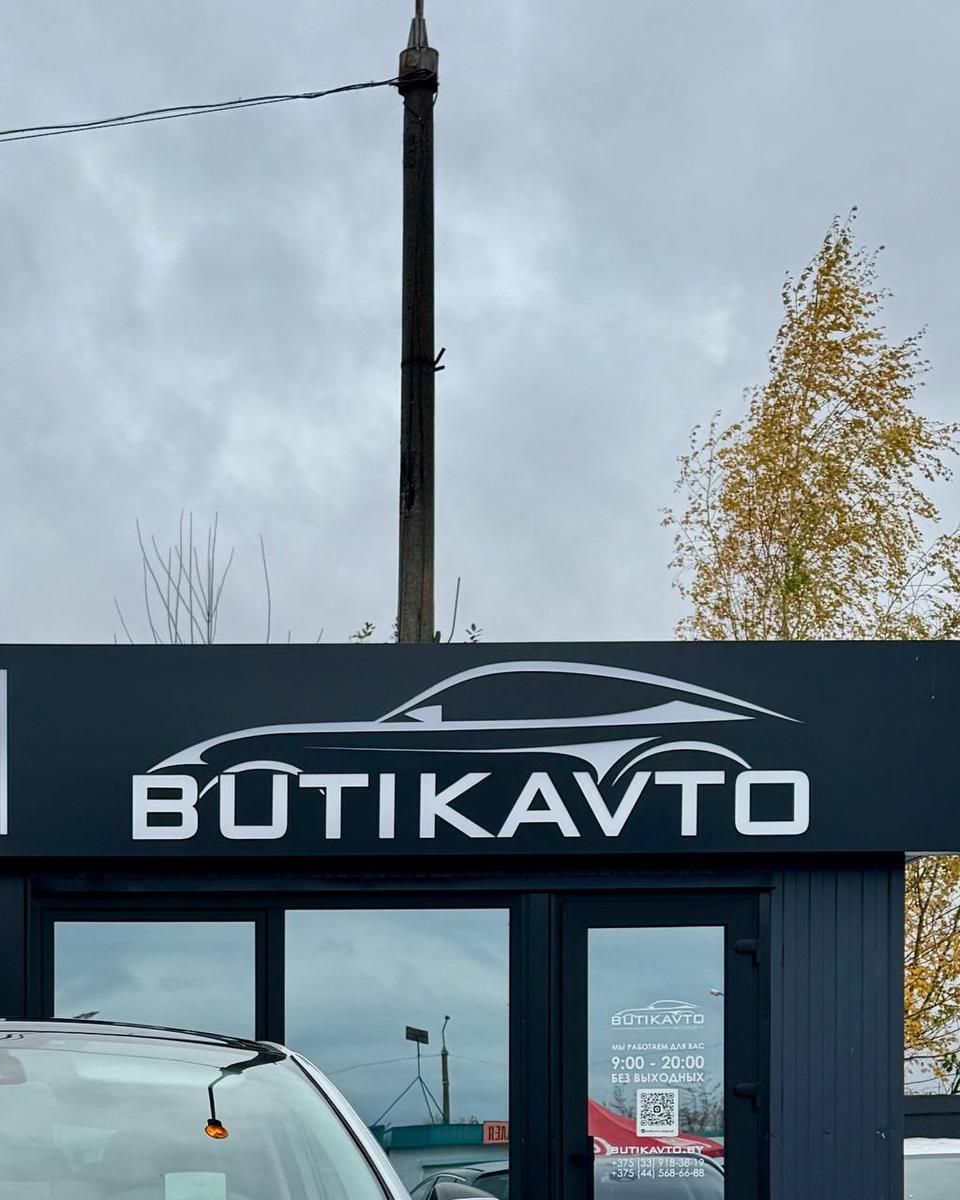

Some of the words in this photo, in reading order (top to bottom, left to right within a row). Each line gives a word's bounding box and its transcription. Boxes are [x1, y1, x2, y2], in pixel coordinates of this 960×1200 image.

[132, 769, 810, 840] BUTIKAVTO
[611, 1014, 705, 1026] BUTIKAVTO
[612, 1043, 626, 1051] МЫ
[627, 1043, 669, 1051] РАБОТАЕМ
[670, 1043, 687, 1051] ДЛЯ
[688, 1042, 705, 1050] ВАС
[611, 1056, 645, 1070] 9:00
[661, 1055, 705, 1069] 20:00
[611, 1073, 631, 1083] БЕЗ
[634, 1072, 705, 1084] ВЫХОДНЫХ
[611, 1146, 705, 1155] BUTIKAVTO.BY
[612, 1159, 635, 1169] +375
[612, 1169, 635, 1179] +375
[637, 1169, 656, 1180] (44)
[658, 1169, 705, 1178] 568-66-88
